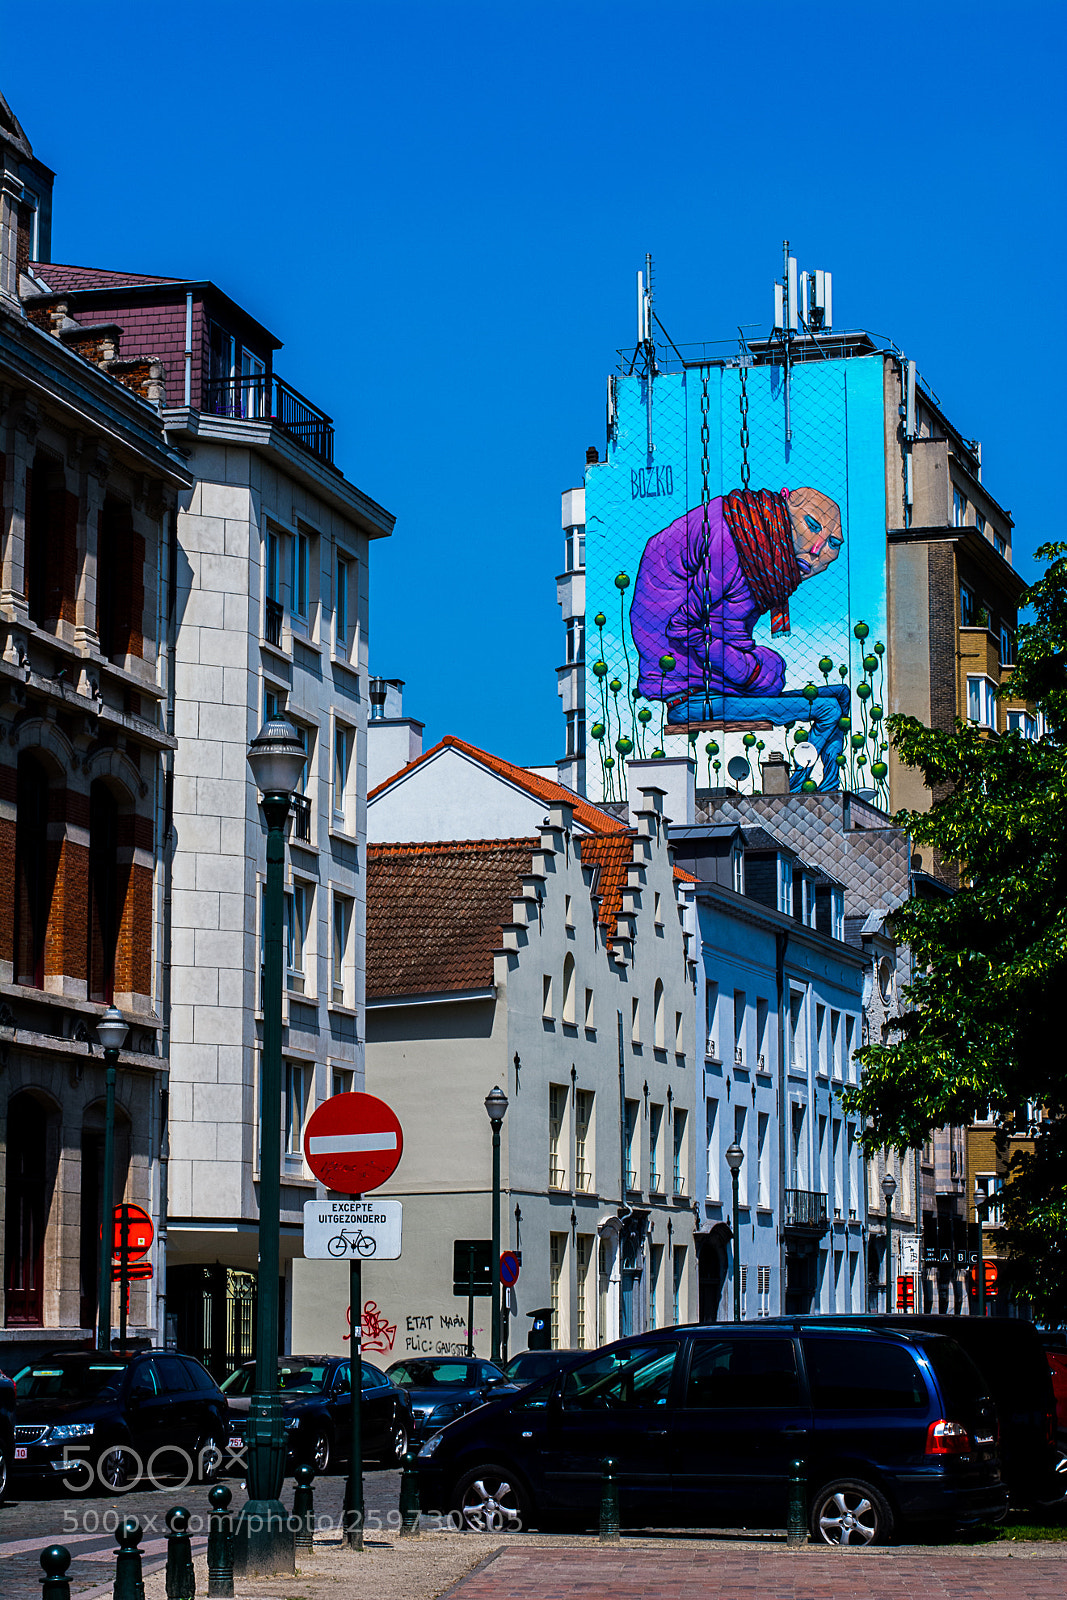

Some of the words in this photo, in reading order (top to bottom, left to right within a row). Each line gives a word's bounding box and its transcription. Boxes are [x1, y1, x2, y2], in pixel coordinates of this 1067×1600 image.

[630, 465, 674, 500] BOZKO
[332, 1203, 373, 1212] EXCEPTE
[318, 1214, 387, 1223] UITGEZONDERD
[406, 1315, 434, 1331] ETAT
